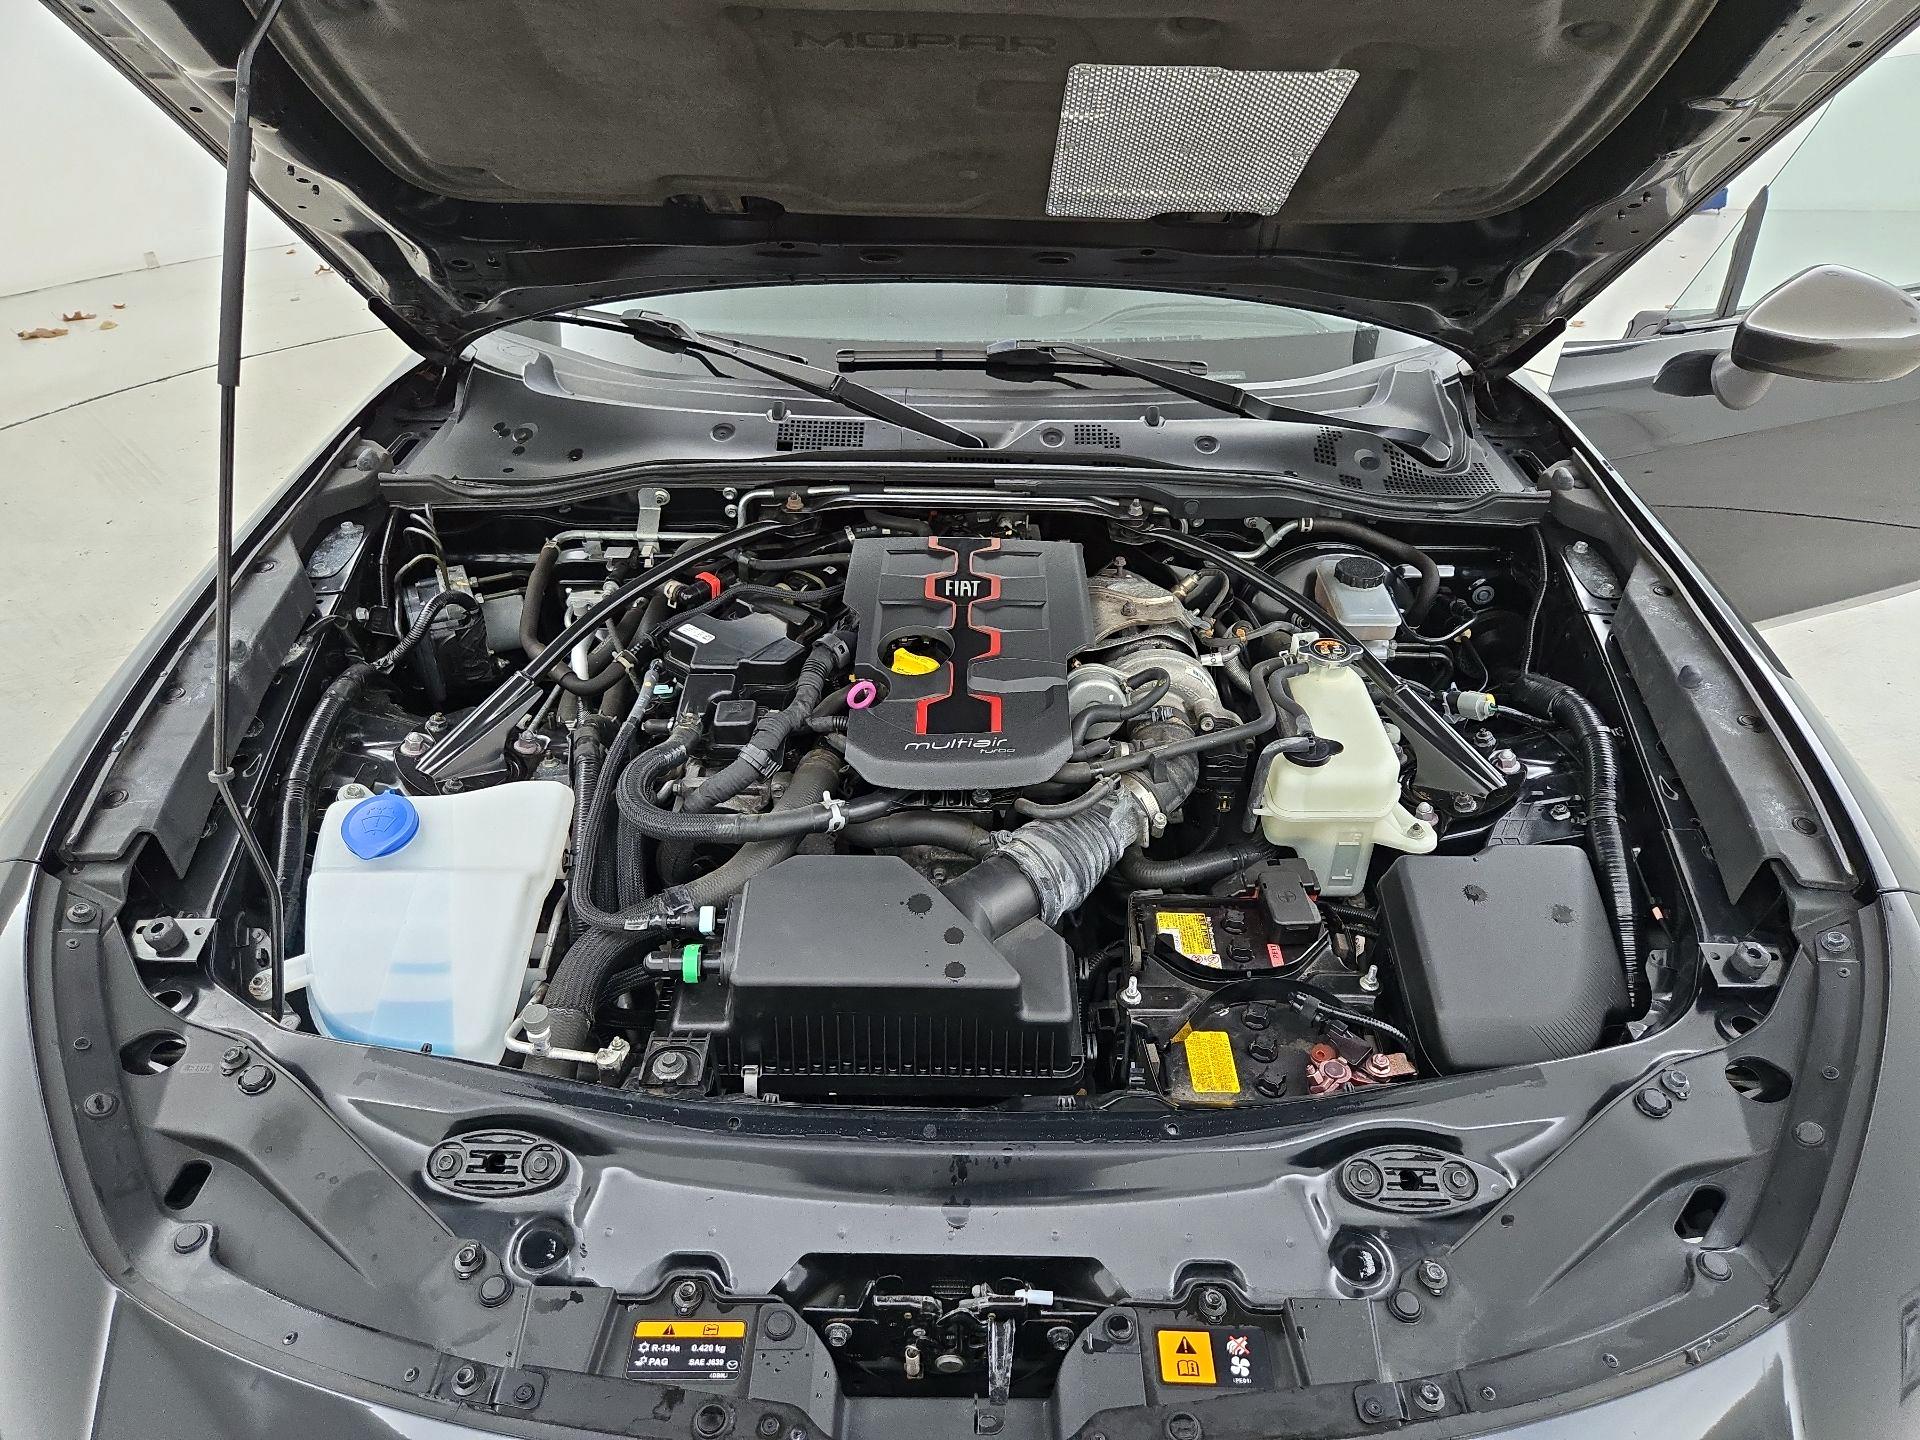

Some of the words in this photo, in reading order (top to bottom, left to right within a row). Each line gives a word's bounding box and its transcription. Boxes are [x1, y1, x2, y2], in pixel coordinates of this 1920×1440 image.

[792, 33, 1057, 53] MOPAR
[945, 580, 981, 596] FIAT
[905, 737, 1007, 750] multiair
[651, 1344, 680, 1353] R-134a
[715, 1344, 726, 1354] kg
[648, 1358, 669, 1366] PAG
[688, 1358, 705, 1366] SAE
